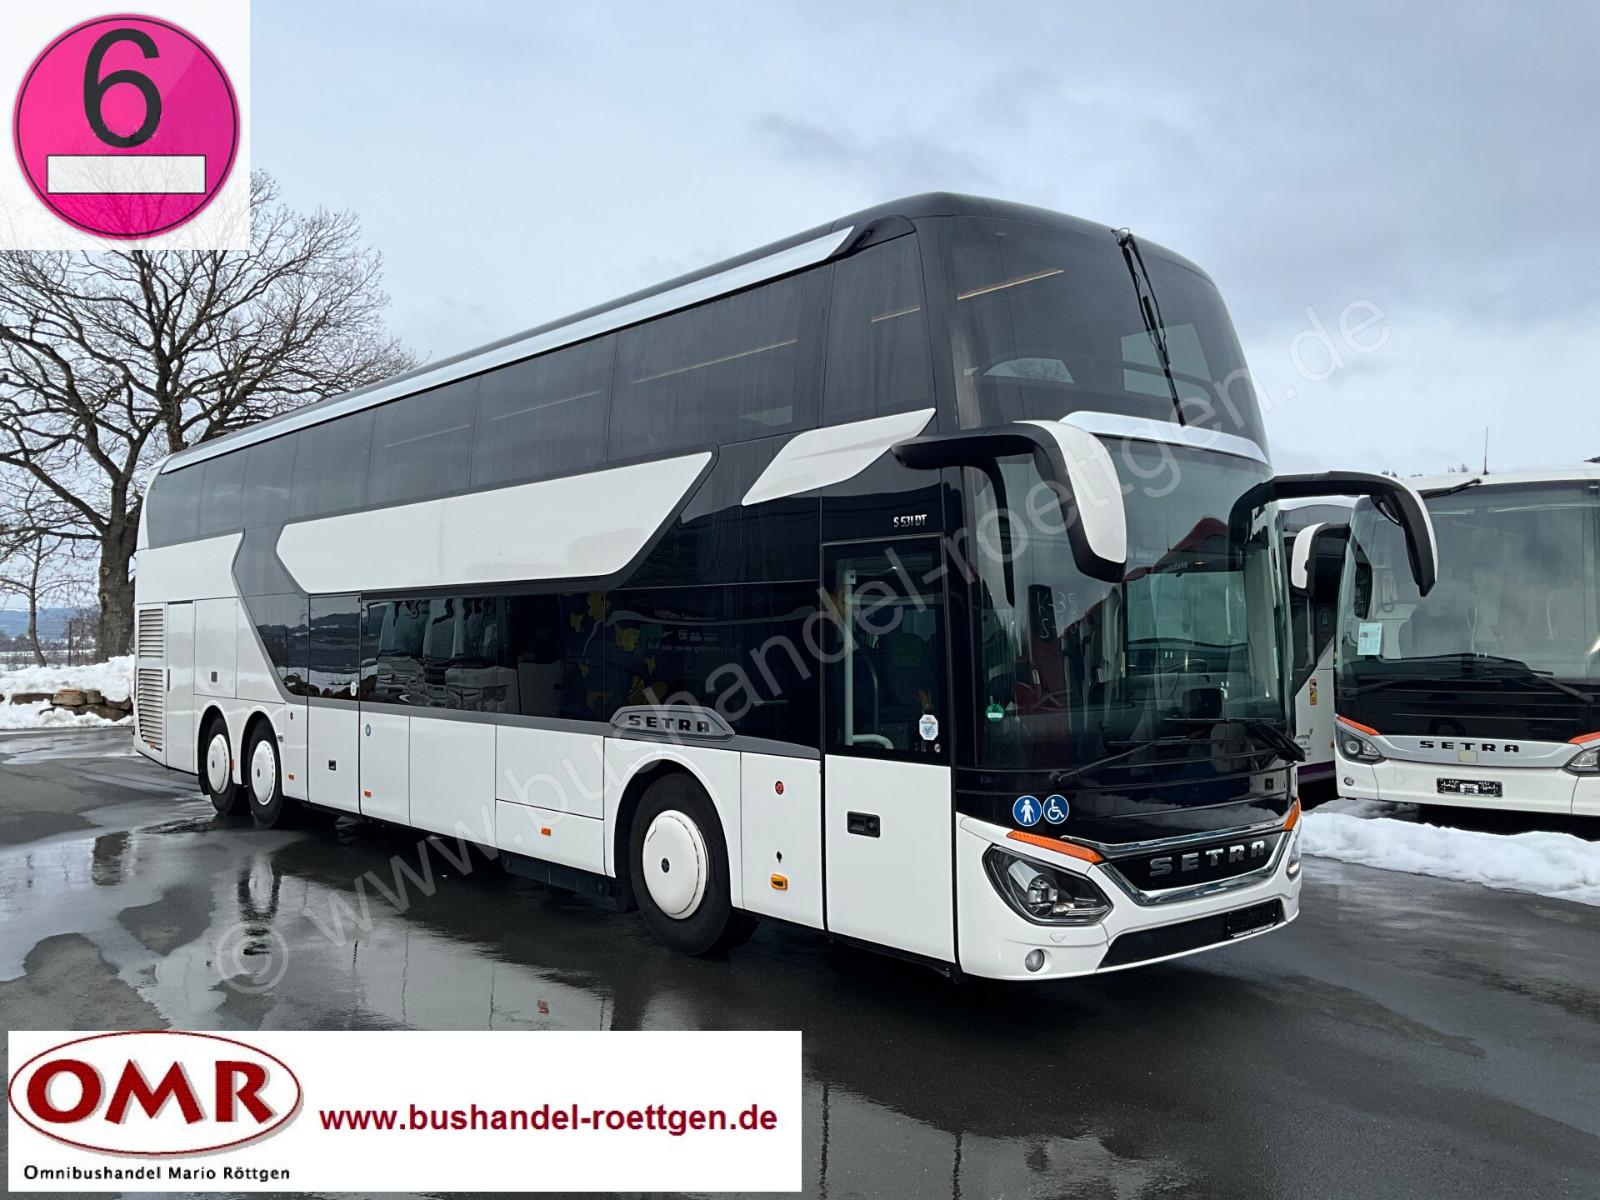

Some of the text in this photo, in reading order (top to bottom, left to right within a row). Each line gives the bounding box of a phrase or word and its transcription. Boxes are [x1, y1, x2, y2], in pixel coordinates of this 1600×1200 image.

[893, 513, 928, 528] S 531 DT
[627, 714, 711, 734] SETRA
[1419, 740, 1520, 753] SETRA
[1149, 839, 1266, 877] SETRA
